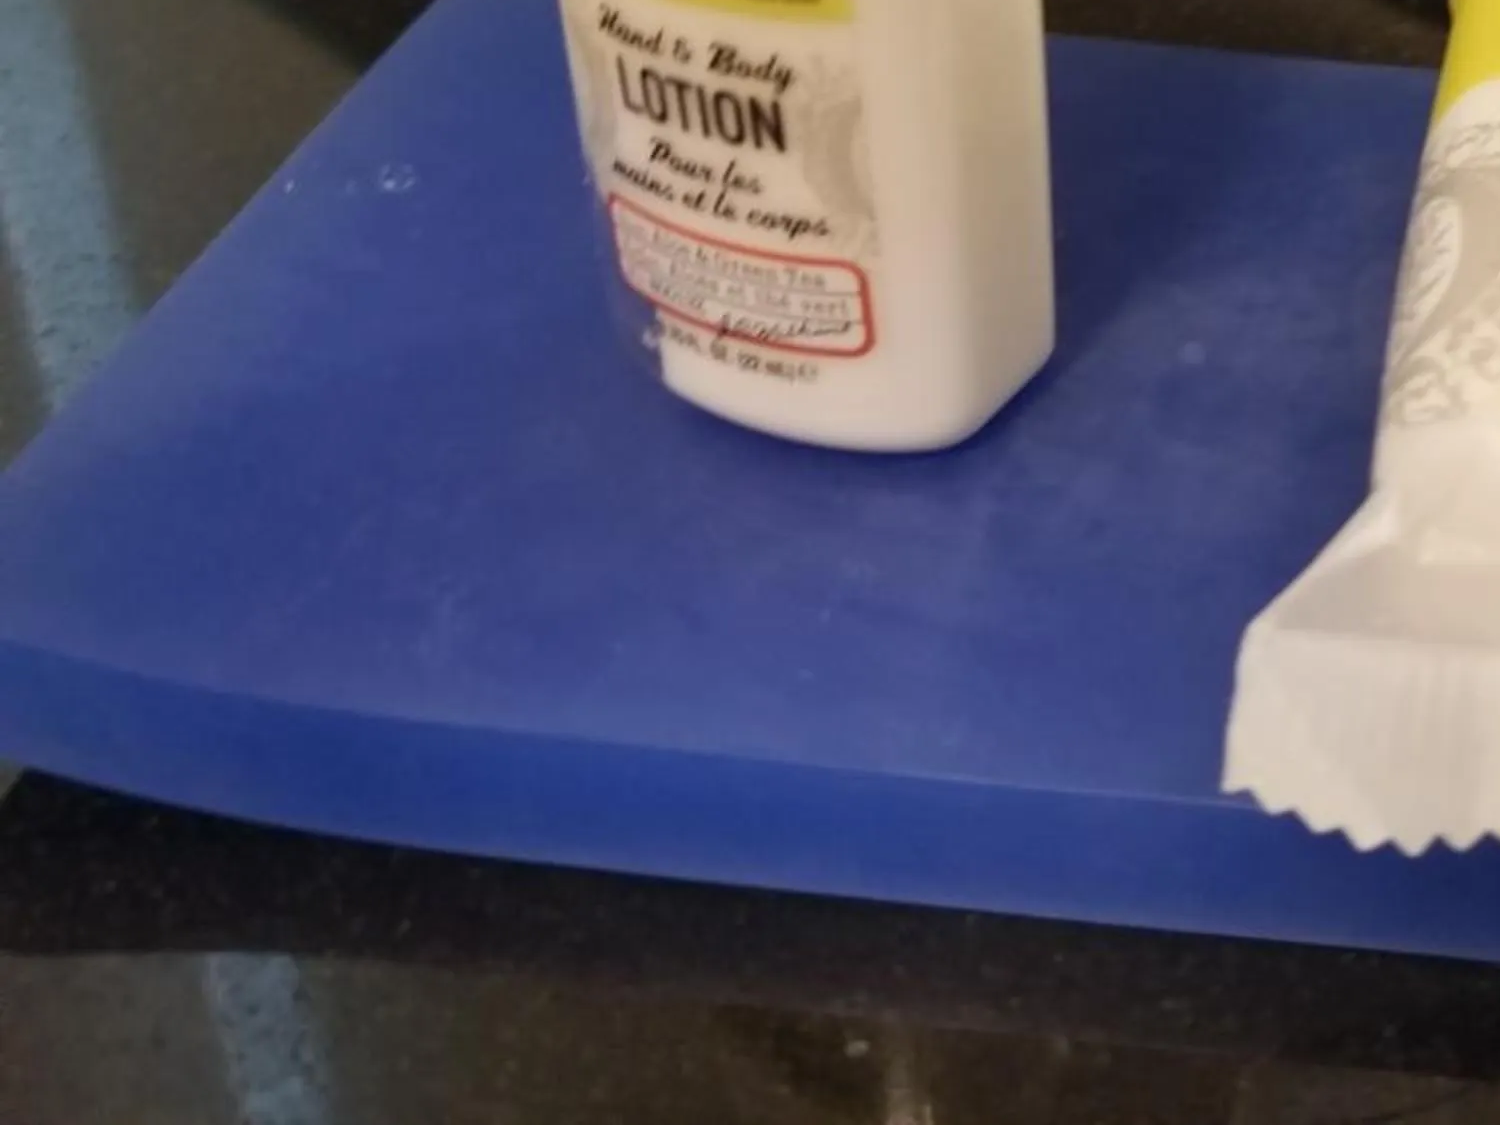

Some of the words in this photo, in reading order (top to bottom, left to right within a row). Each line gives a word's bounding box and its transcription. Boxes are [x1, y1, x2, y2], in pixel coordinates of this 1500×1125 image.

[598, 3, 664, 55] Hand
[672, 35, 692, 64] &
[708, 41, 794, 94] Body
[615, 55, 787, 154] LOTION
[612, 157, 675, 203] mains
[681, 189, 705, 213] et
[713, 190, 737, 221] le
[747, 208, 830, 241] corps
[649, 136, 714, 184] Pour
[722, 158, 762, 194] les
